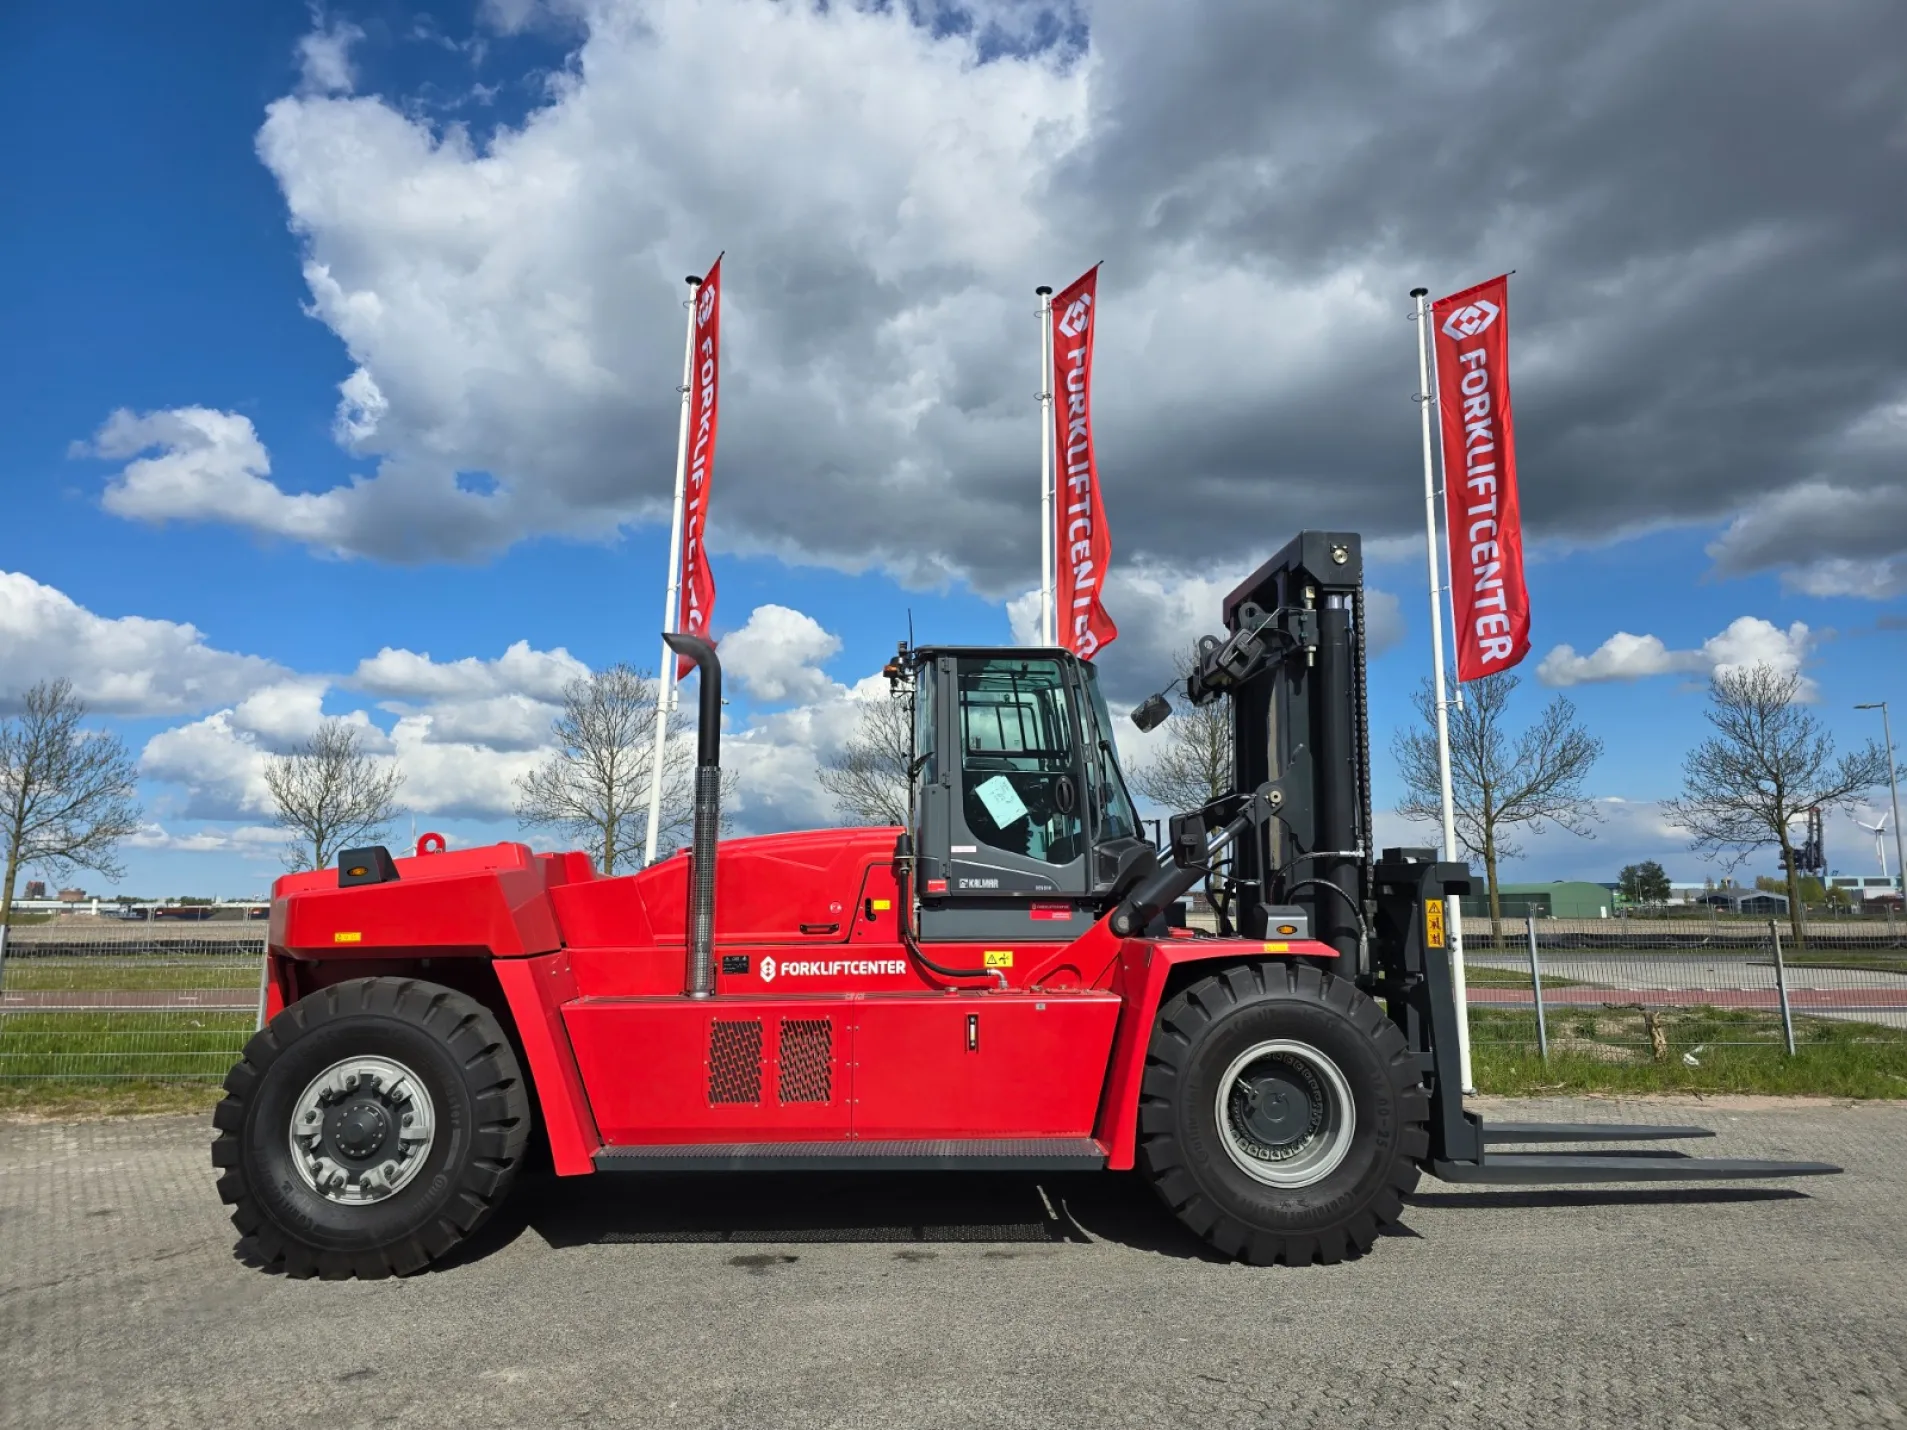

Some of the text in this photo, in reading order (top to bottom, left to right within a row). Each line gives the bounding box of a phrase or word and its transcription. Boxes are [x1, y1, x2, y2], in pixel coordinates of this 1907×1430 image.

[1459, 348, 1513, 664] FORKLIFTCENTER
[968, 878, 999, 889] KALMAR
[780, 960, 906, 976] FORKLIFTCENTER
